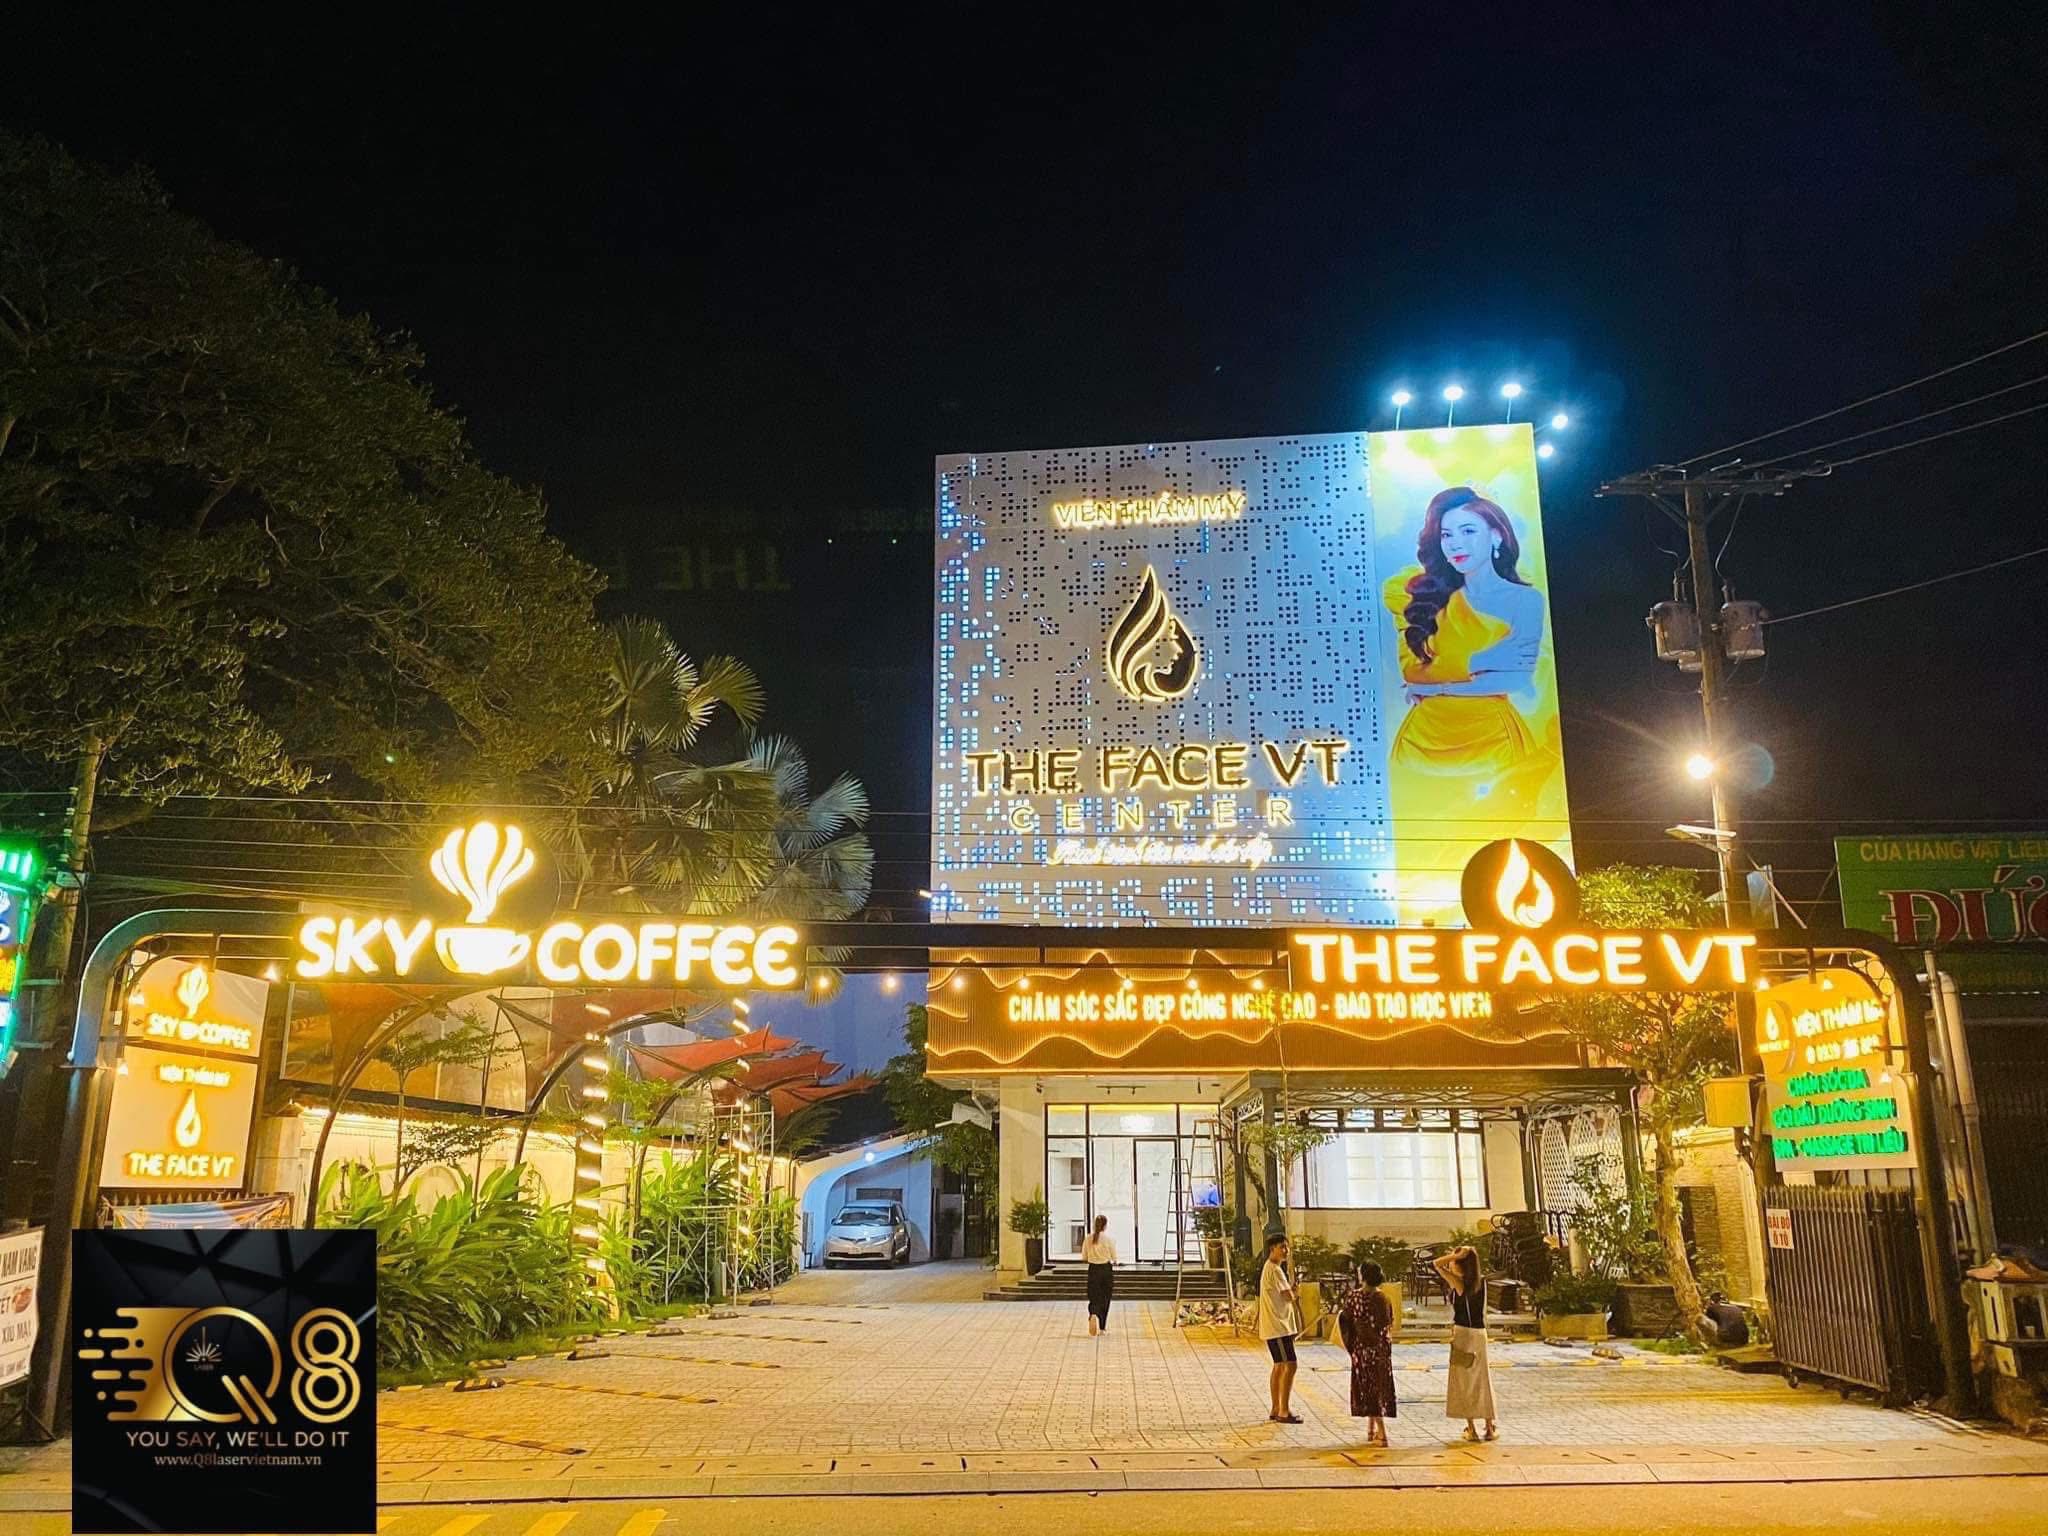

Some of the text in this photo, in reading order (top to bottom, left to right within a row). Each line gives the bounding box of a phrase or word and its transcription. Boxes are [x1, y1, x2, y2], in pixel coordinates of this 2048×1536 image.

[966, 741, 1350, 795] THE FACE VT
[1009, 797, 1296, 832] CENTER
[296, 917, 799, 986] SKY COFFEE
[1294, 933, 1758, 985] THE FACE VT
[1280, 992, 1316, 1020] CAO
[128, 1152, 234, 1177] THE FACE VT
